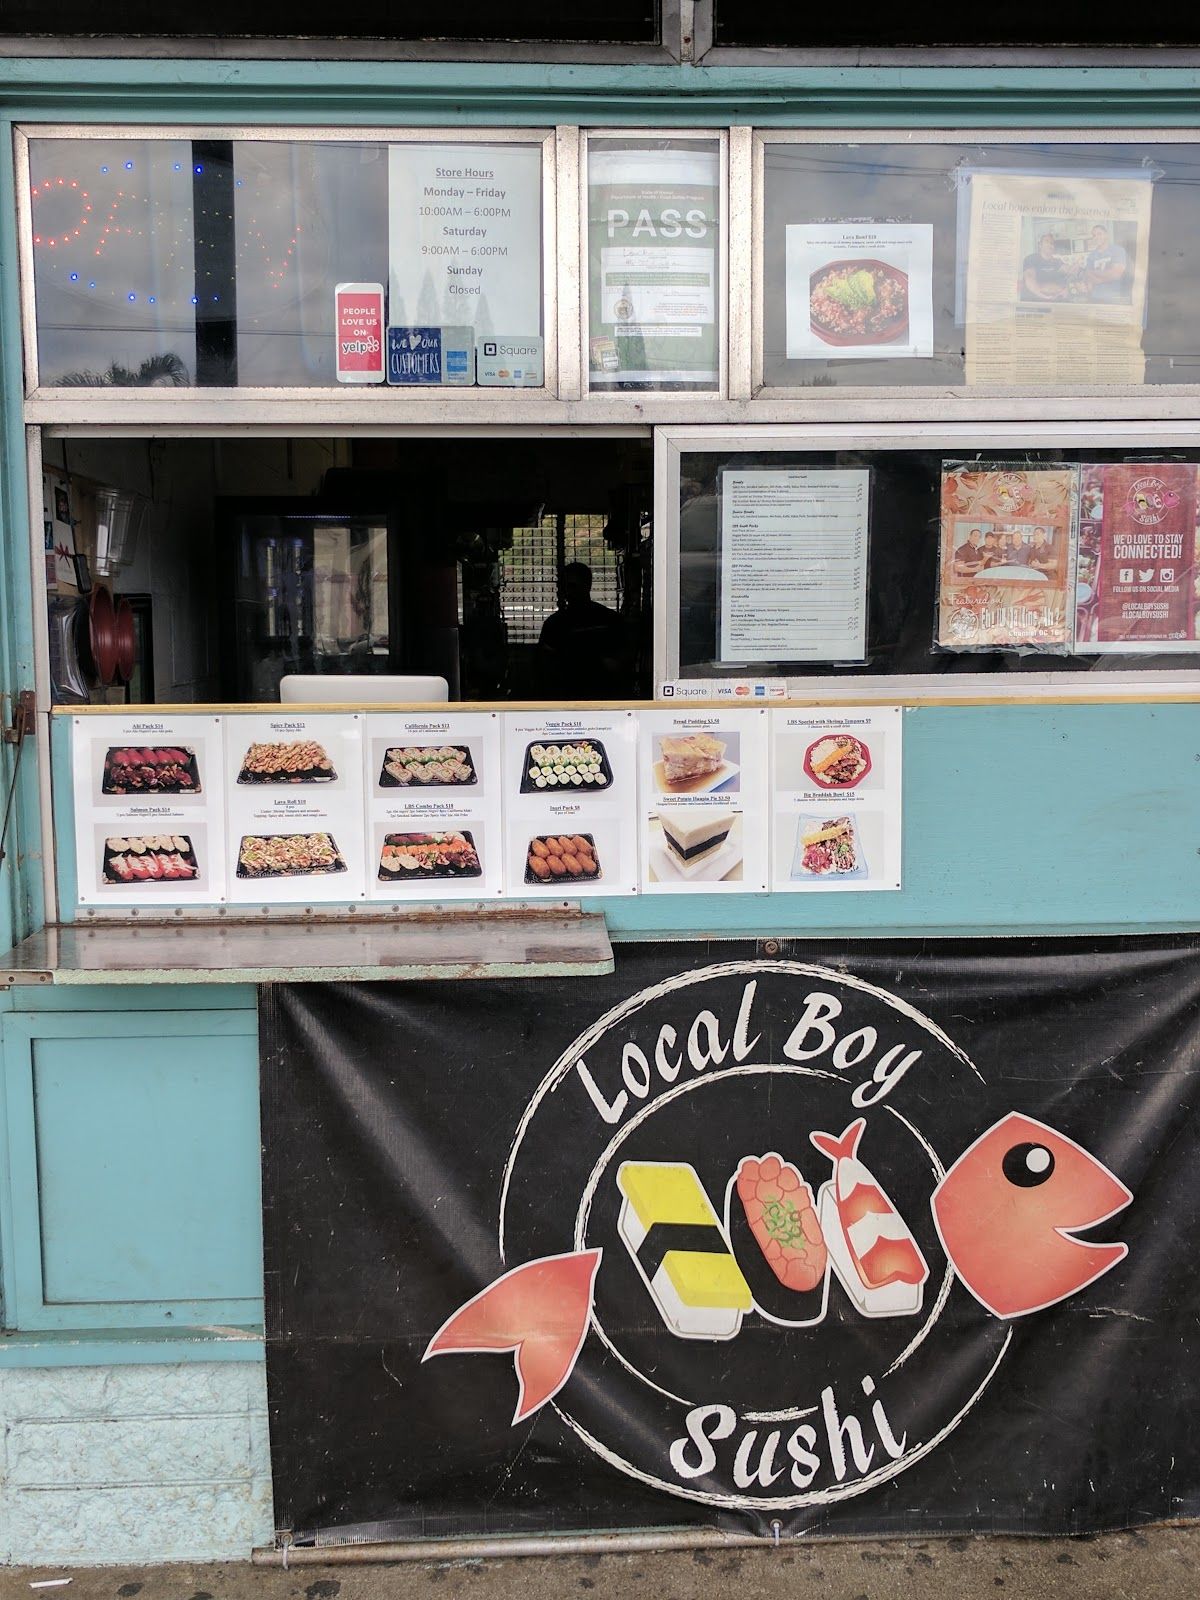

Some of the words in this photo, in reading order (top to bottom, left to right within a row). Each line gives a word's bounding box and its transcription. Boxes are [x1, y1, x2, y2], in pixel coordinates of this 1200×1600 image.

[435, 167, 462, 177] Store
[465, 168, 494, 178] Hours
[423, 187, 465, 198] Monday
[476, 187, 506, 200] Friday
[418, 206, 463, 216] 10:00AM
[473, 207, 511, 217] 6:00PM
[607, 208, 707, 239] PASS
[442, 226, 487, 238] Saturday
[421, 245, 460, 255] 9:00AM
[470, 246, 508, 256] 6:00PM
[447, 265, 483, 277] Sunday
[449, 284, 481, 295] Closed
[366, 318, 378, 326] US
[342, 340, 368, 355] yelp
[500, 346, 537, 356] Square
[391, 352, 440, 375] CUSTOMERS
[1113, 534, 1132, 544] WE'D
[1133, 534, 1153, 544] LOVE
[1154, 534, 1164, 544] TO
[1165, 534, 1184, 544] STAY
[1114, 544, 1182, 559] CONNECTED!
[676, 687, 707, 696] Square
[576, 980, 763, 1127] Local
[782, 991, 923, 1110] Boy
[670, 1373, 909, 1491] Sushi
